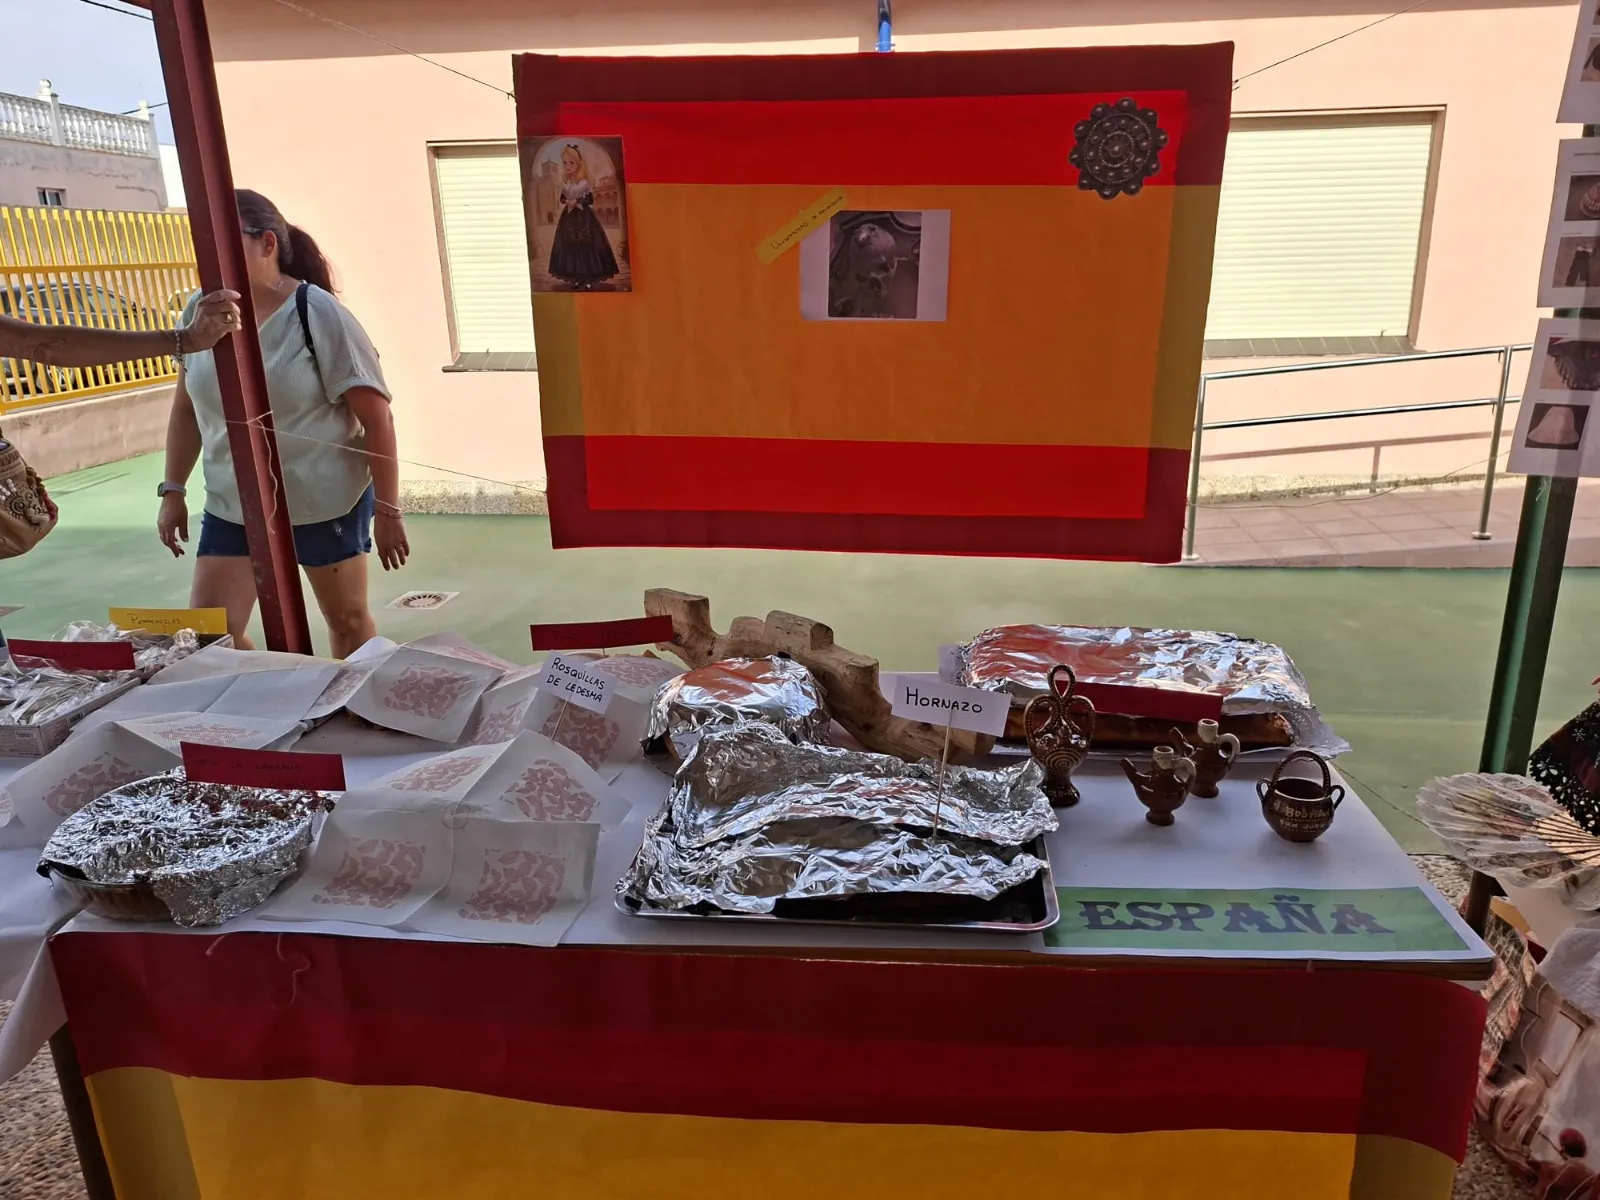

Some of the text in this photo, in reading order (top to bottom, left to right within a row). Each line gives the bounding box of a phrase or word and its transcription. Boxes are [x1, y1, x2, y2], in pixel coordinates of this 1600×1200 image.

[546, 674, 604, 703] DE LEDESMA
[552, 657, 606, 691] ROSQUILLAS
[906, 686, 983, 714] HORNAZO
[1077, 894, 1396, 935] ESPAÑA
